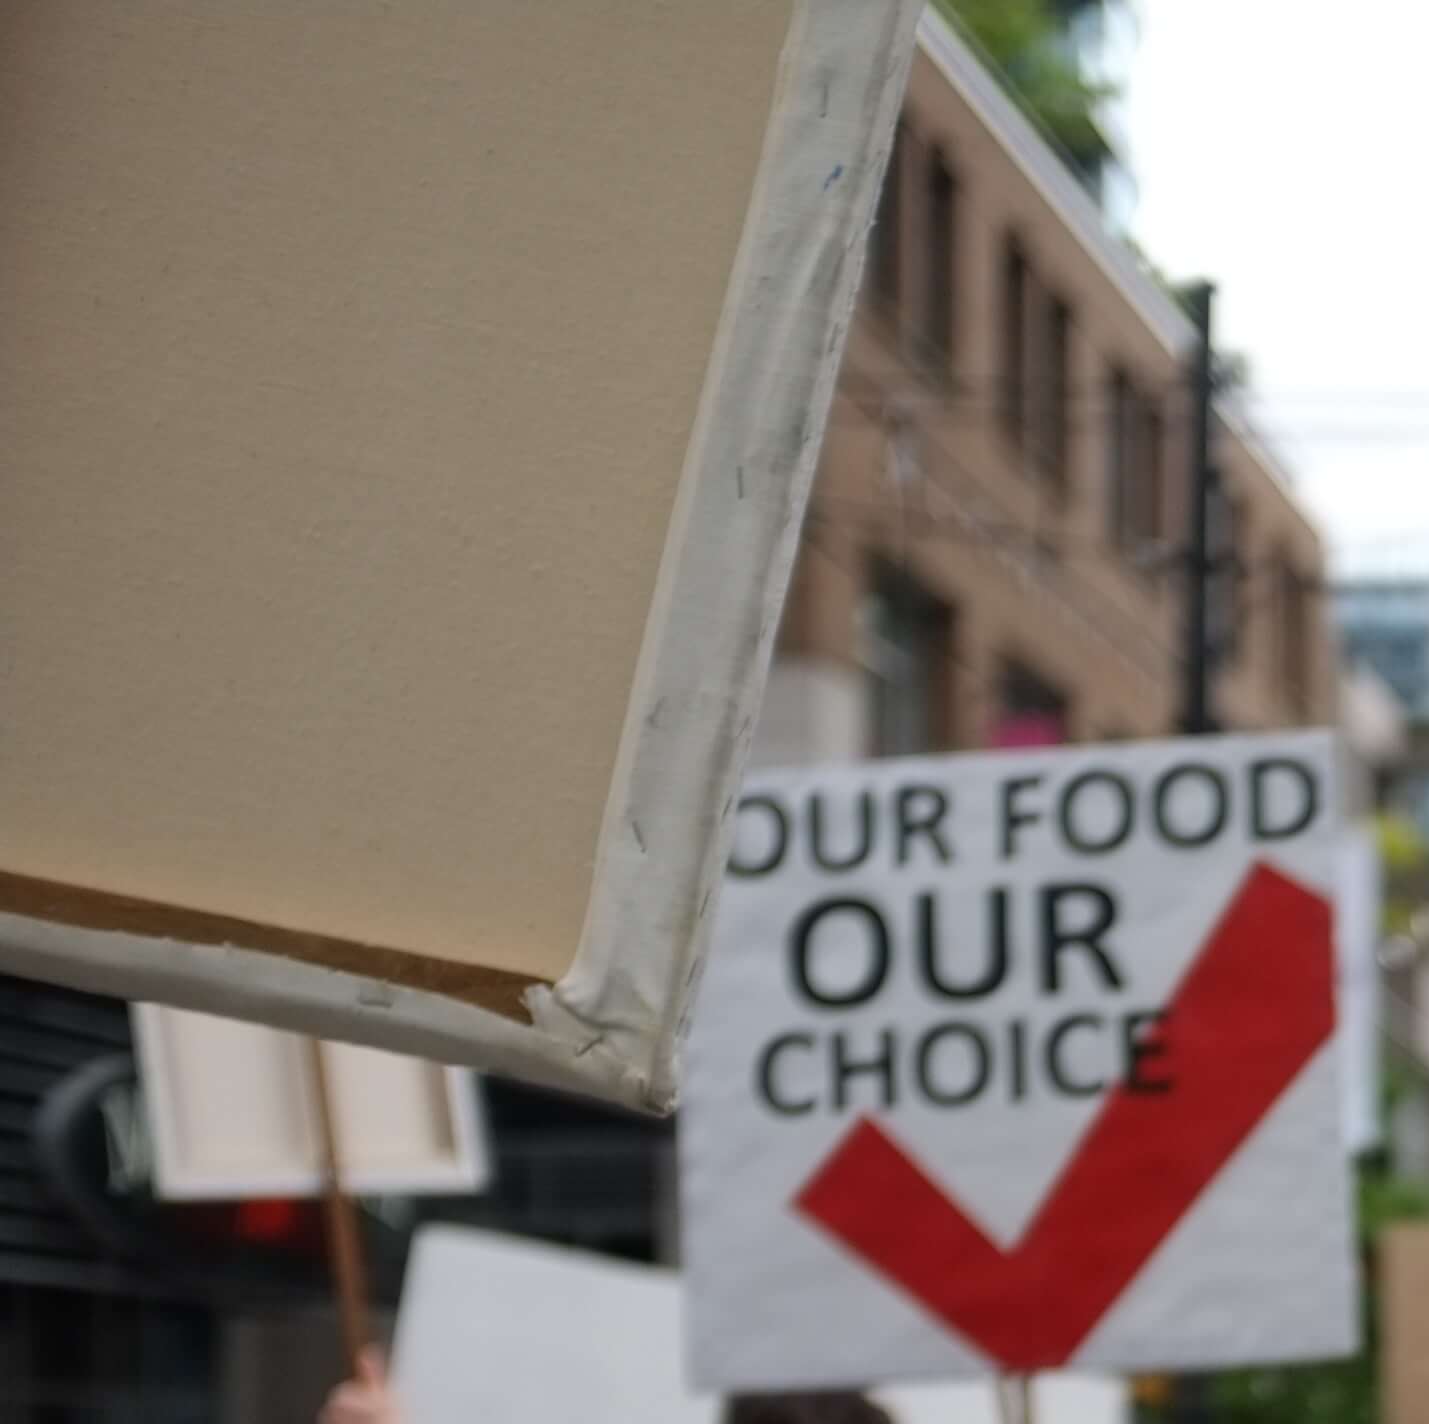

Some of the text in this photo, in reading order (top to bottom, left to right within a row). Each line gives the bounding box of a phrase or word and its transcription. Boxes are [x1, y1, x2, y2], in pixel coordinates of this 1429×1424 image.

[726, 756, 1320, 878] OUR FOOD
[790, 882, 1122, 1009] OUR
[757, 1009, 1172, 1117] CHOICE
